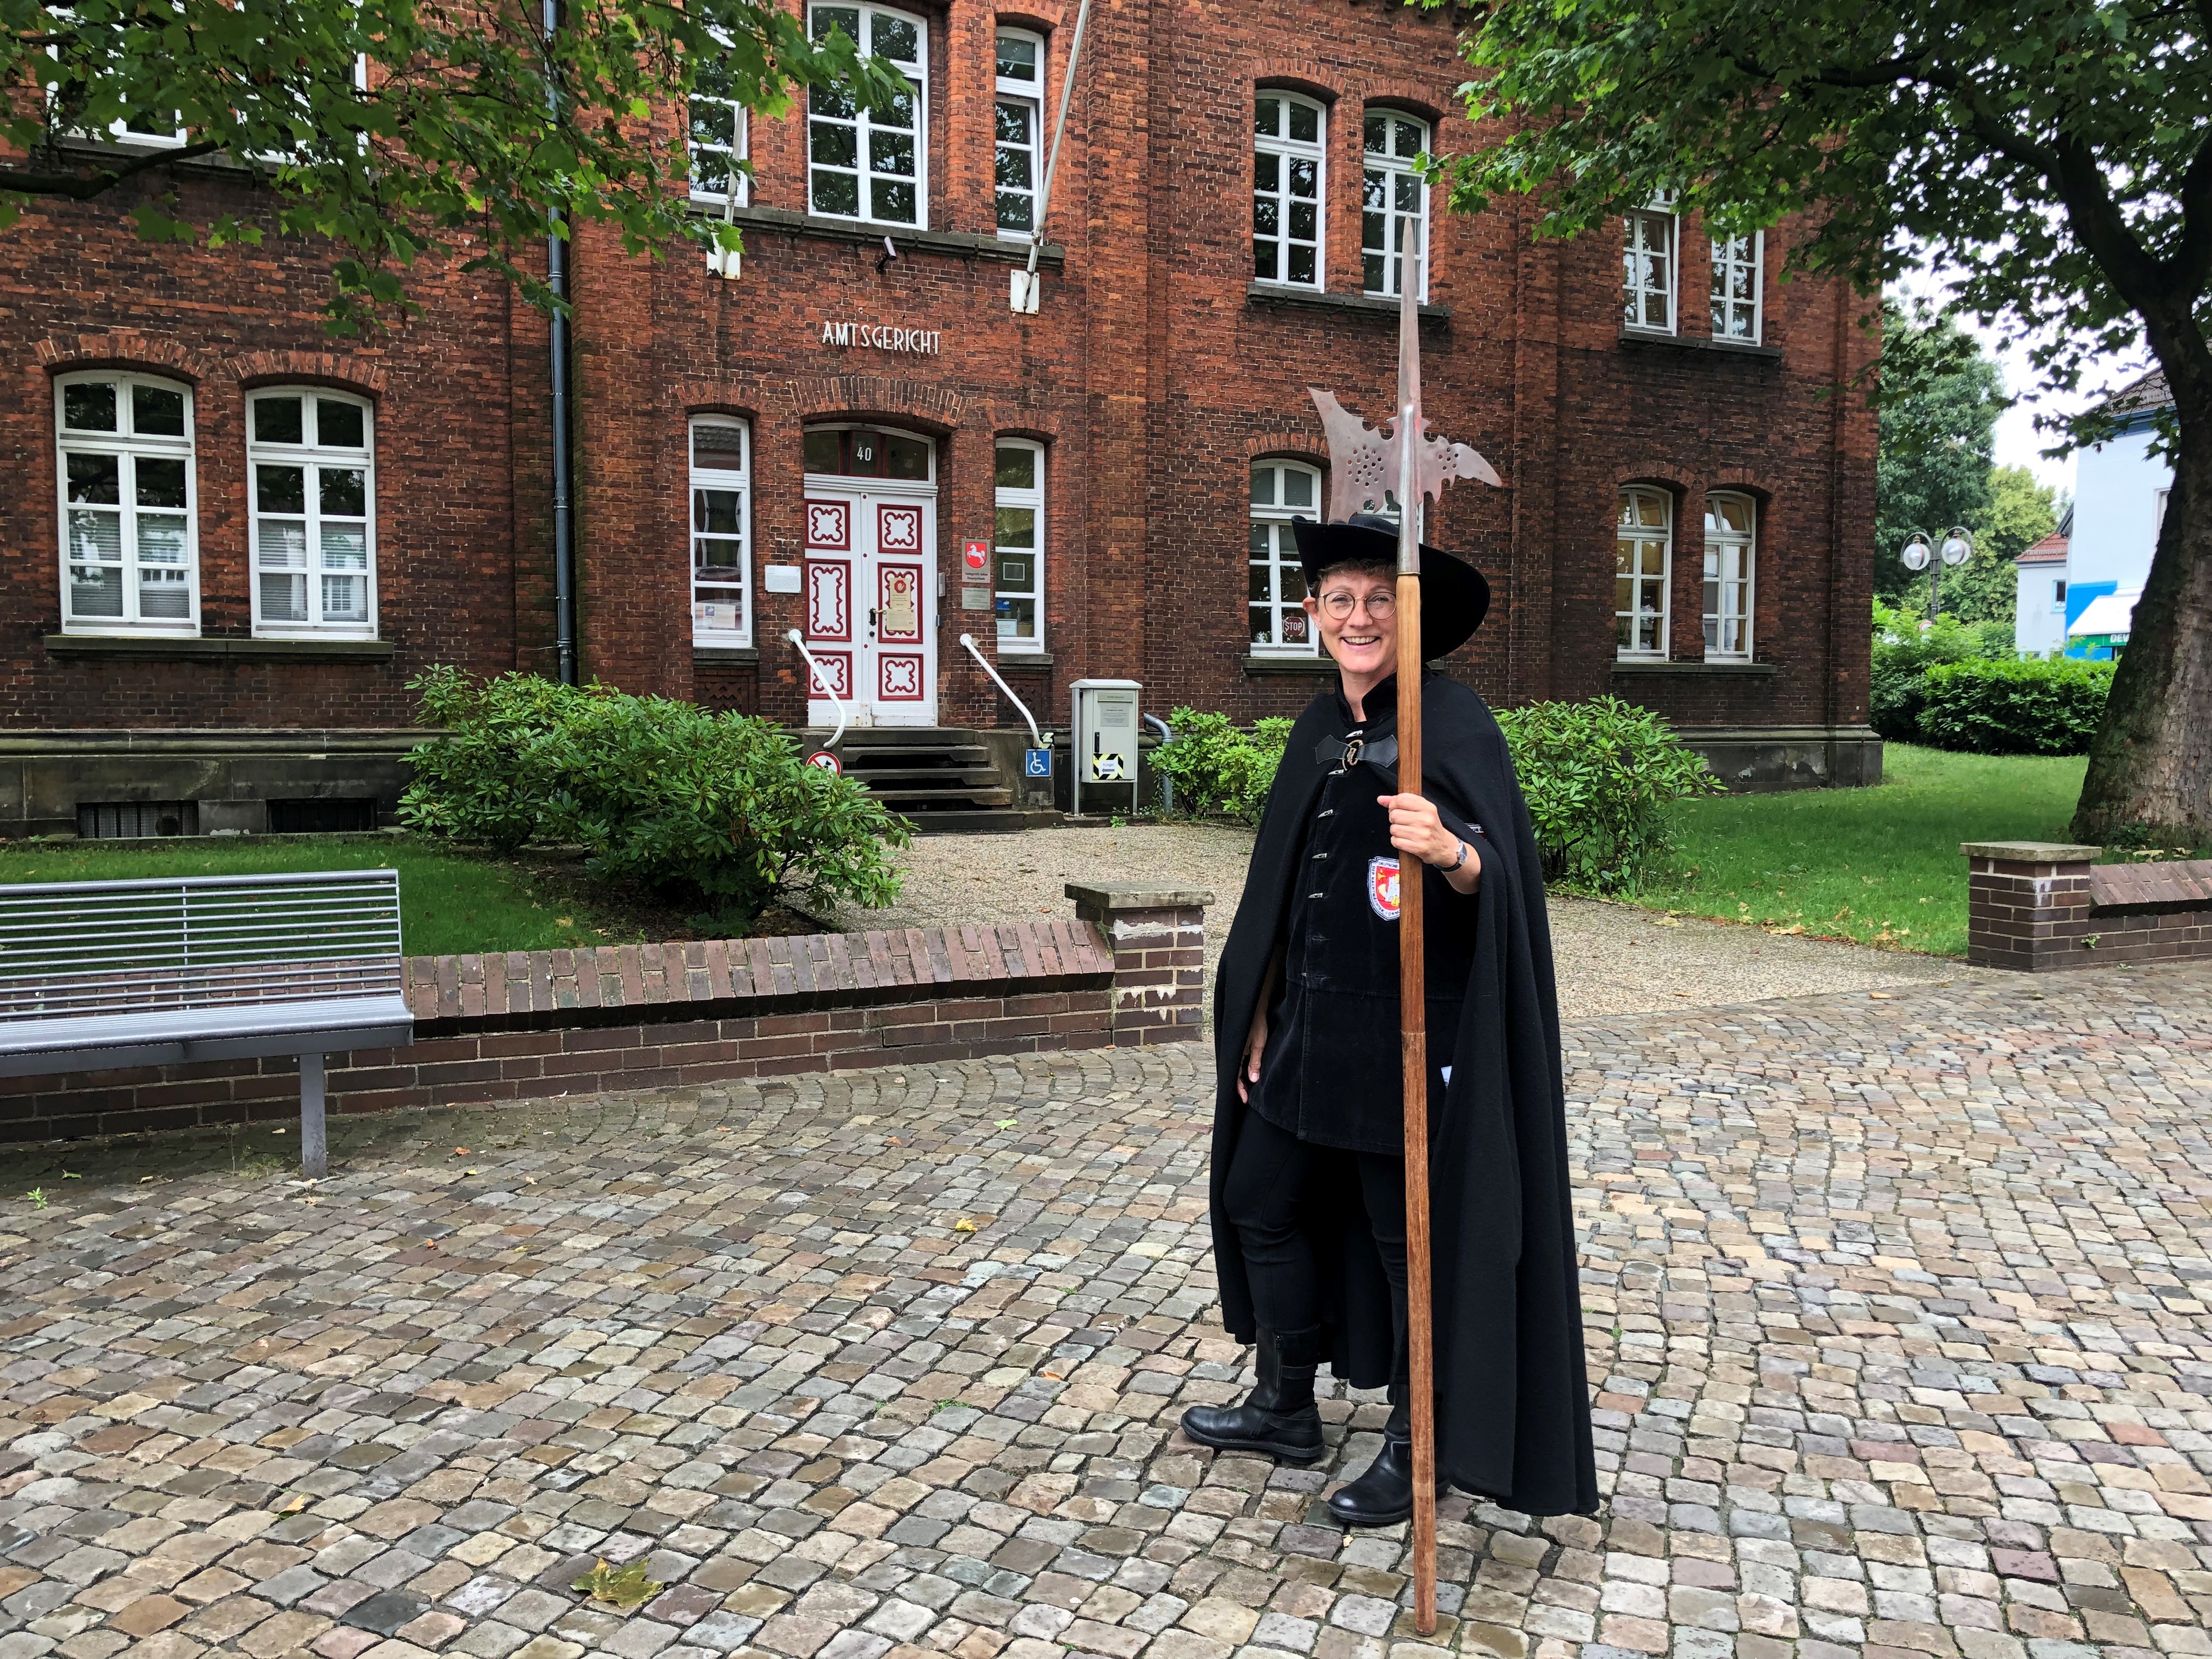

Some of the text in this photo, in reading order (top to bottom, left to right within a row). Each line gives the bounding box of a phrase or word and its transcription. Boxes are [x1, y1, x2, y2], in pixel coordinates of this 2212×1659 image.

[822, 320, 941, 354] AMTSGERICHT
[857, 447, 872, 461] 40
[1285, 622, 1302, 631] STOP
